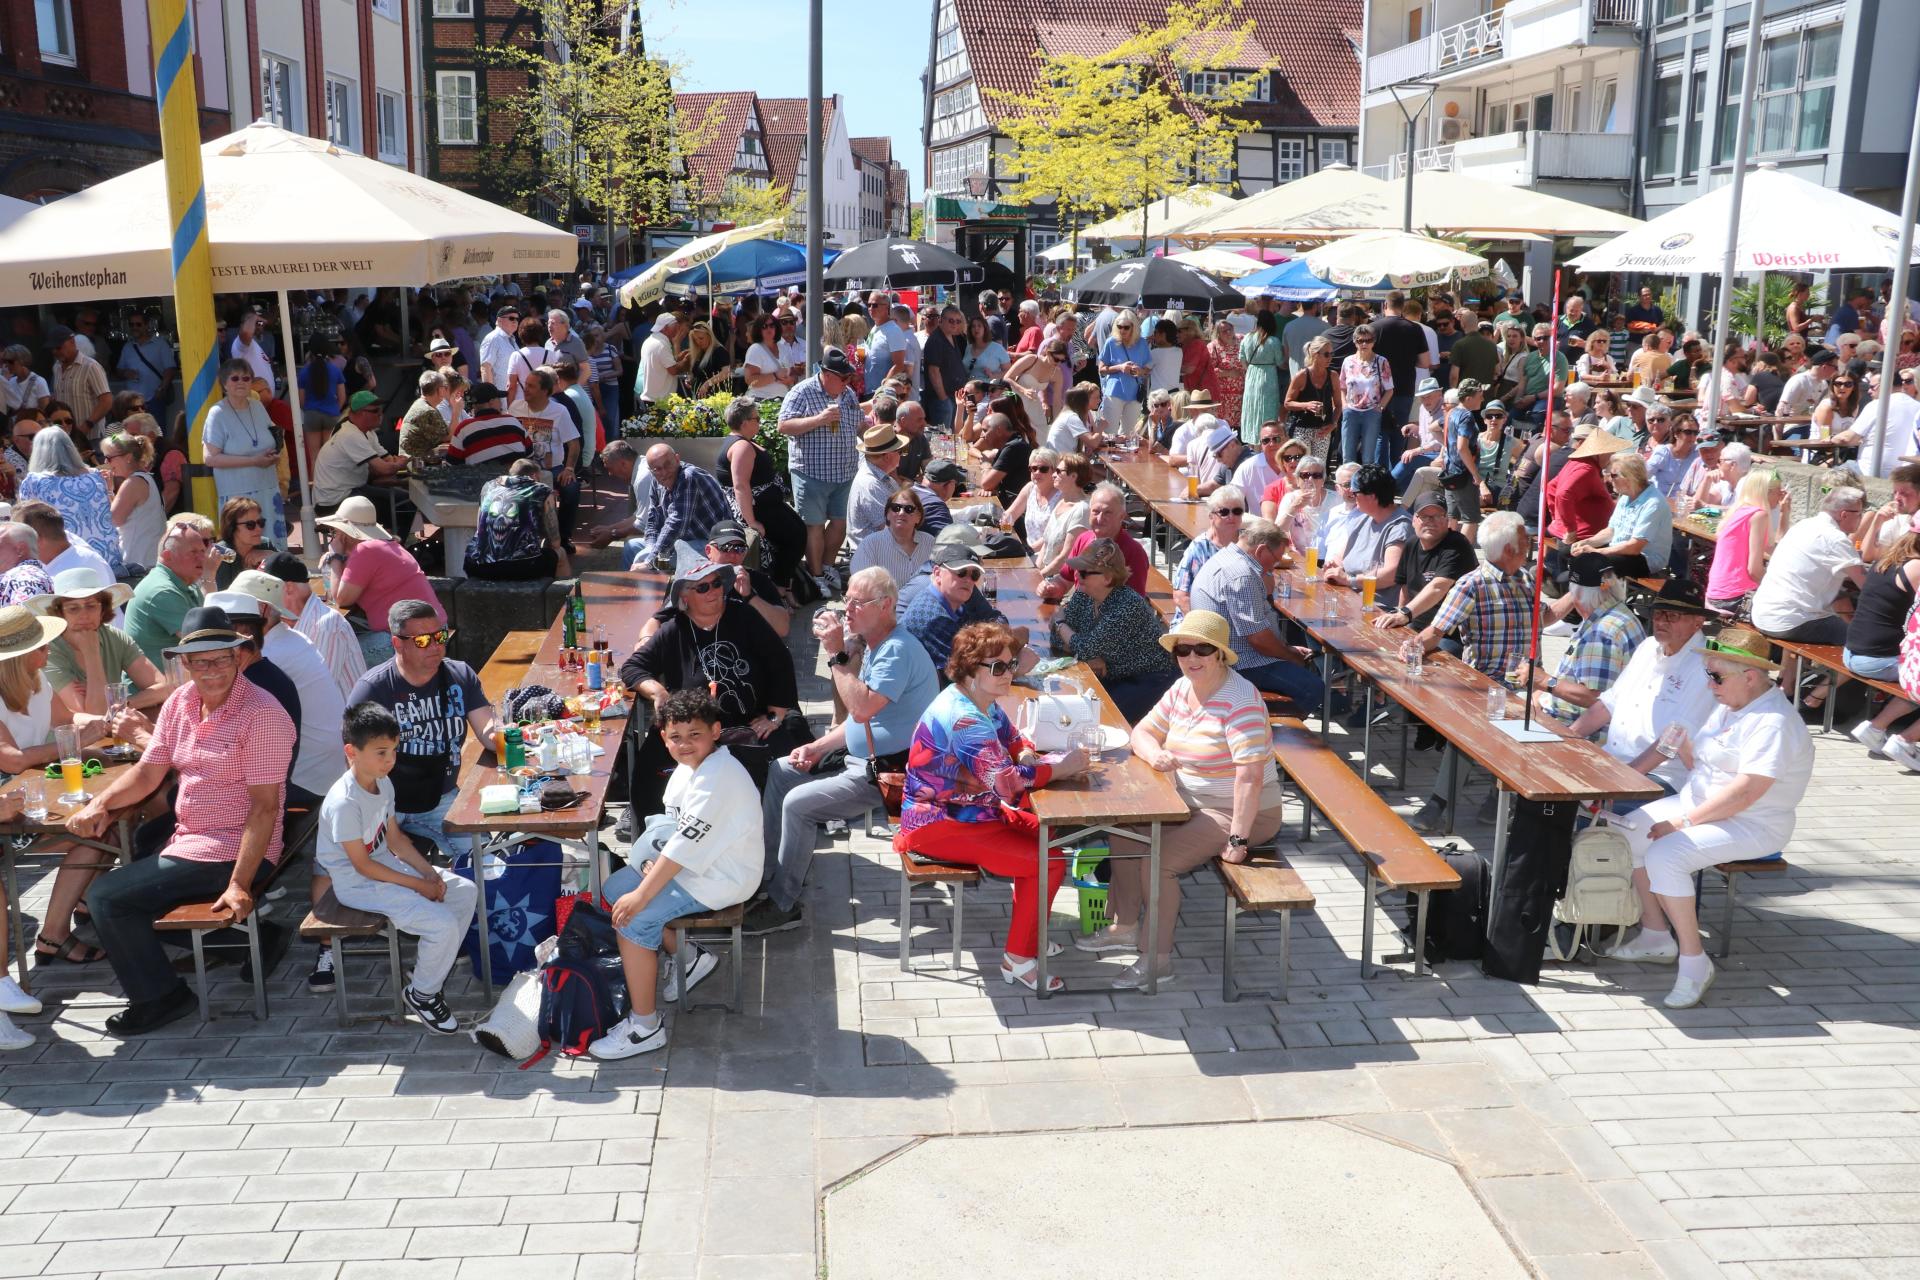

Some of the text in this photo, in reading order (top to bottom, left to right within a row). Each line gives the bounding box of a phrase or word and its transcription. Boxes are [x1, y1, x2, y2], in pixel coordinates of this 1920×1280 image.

[211, 259, 373, 277] TESTE BRAUEREI DER WELT
[1753, 252, 1840, 266] Weissbier
[29, 268, 127, 290] Weihenstephan
[408, 692, 417, 700] 25
[681, 811, 712, 832] LETS
